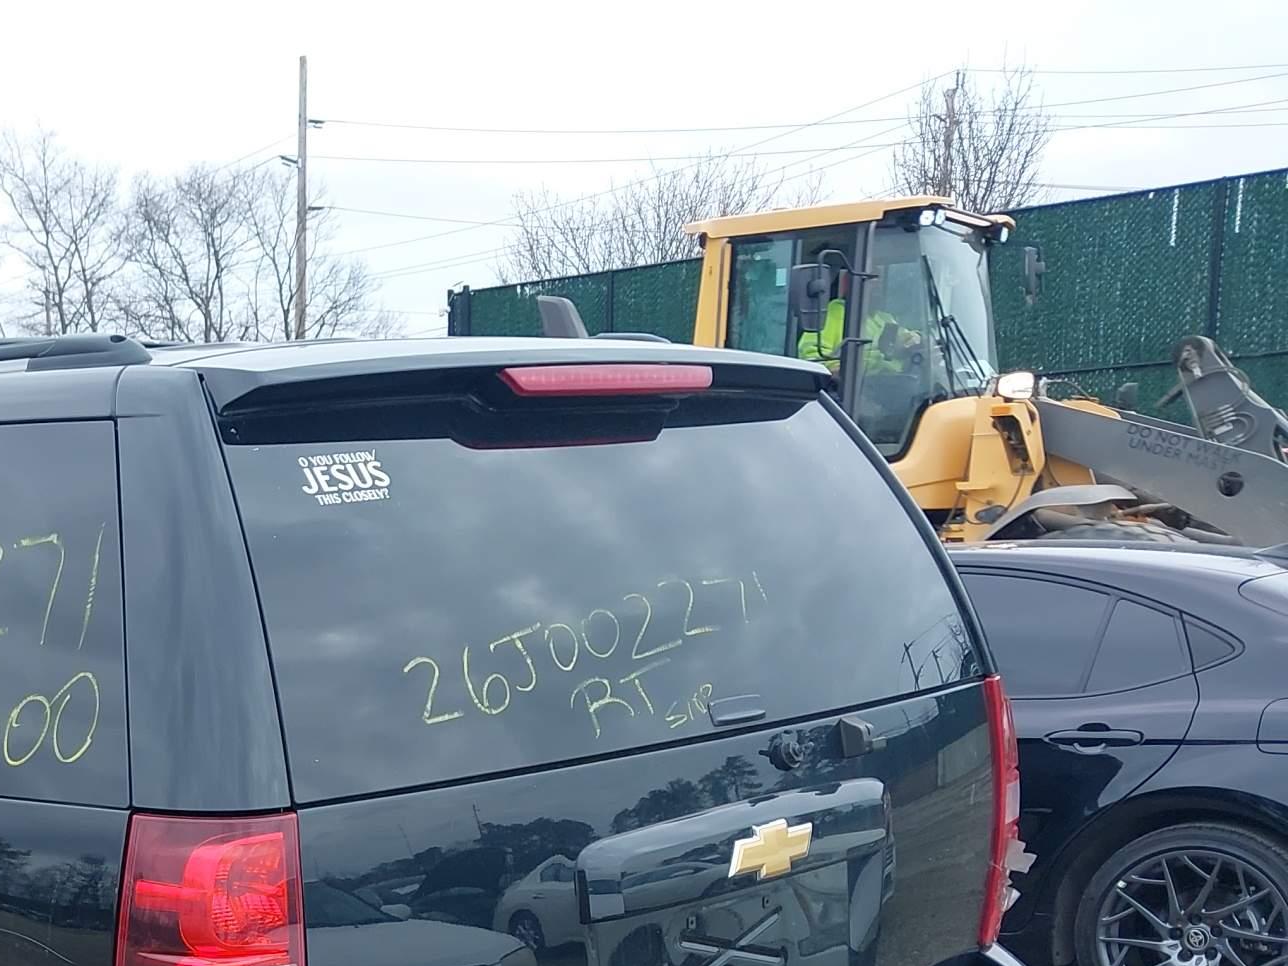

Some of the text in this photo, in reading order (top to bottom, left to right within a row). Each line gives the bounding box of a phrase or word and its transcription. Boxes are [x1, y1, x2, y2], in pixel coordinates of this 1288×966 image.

[1127, 424, 1152, 439] DO
[1155, 431, 1192, 450] NOT
[1129, 437, 1183, 459] UNDER
[309, 454, 334, 466] YOU
[332, 449, 376, 464] FOLLOW
[302, 460, 391, 495] JESUS
[315, 488, 390, 506] THIS CLOSELY?
[569, 658, 671, 739] RT
